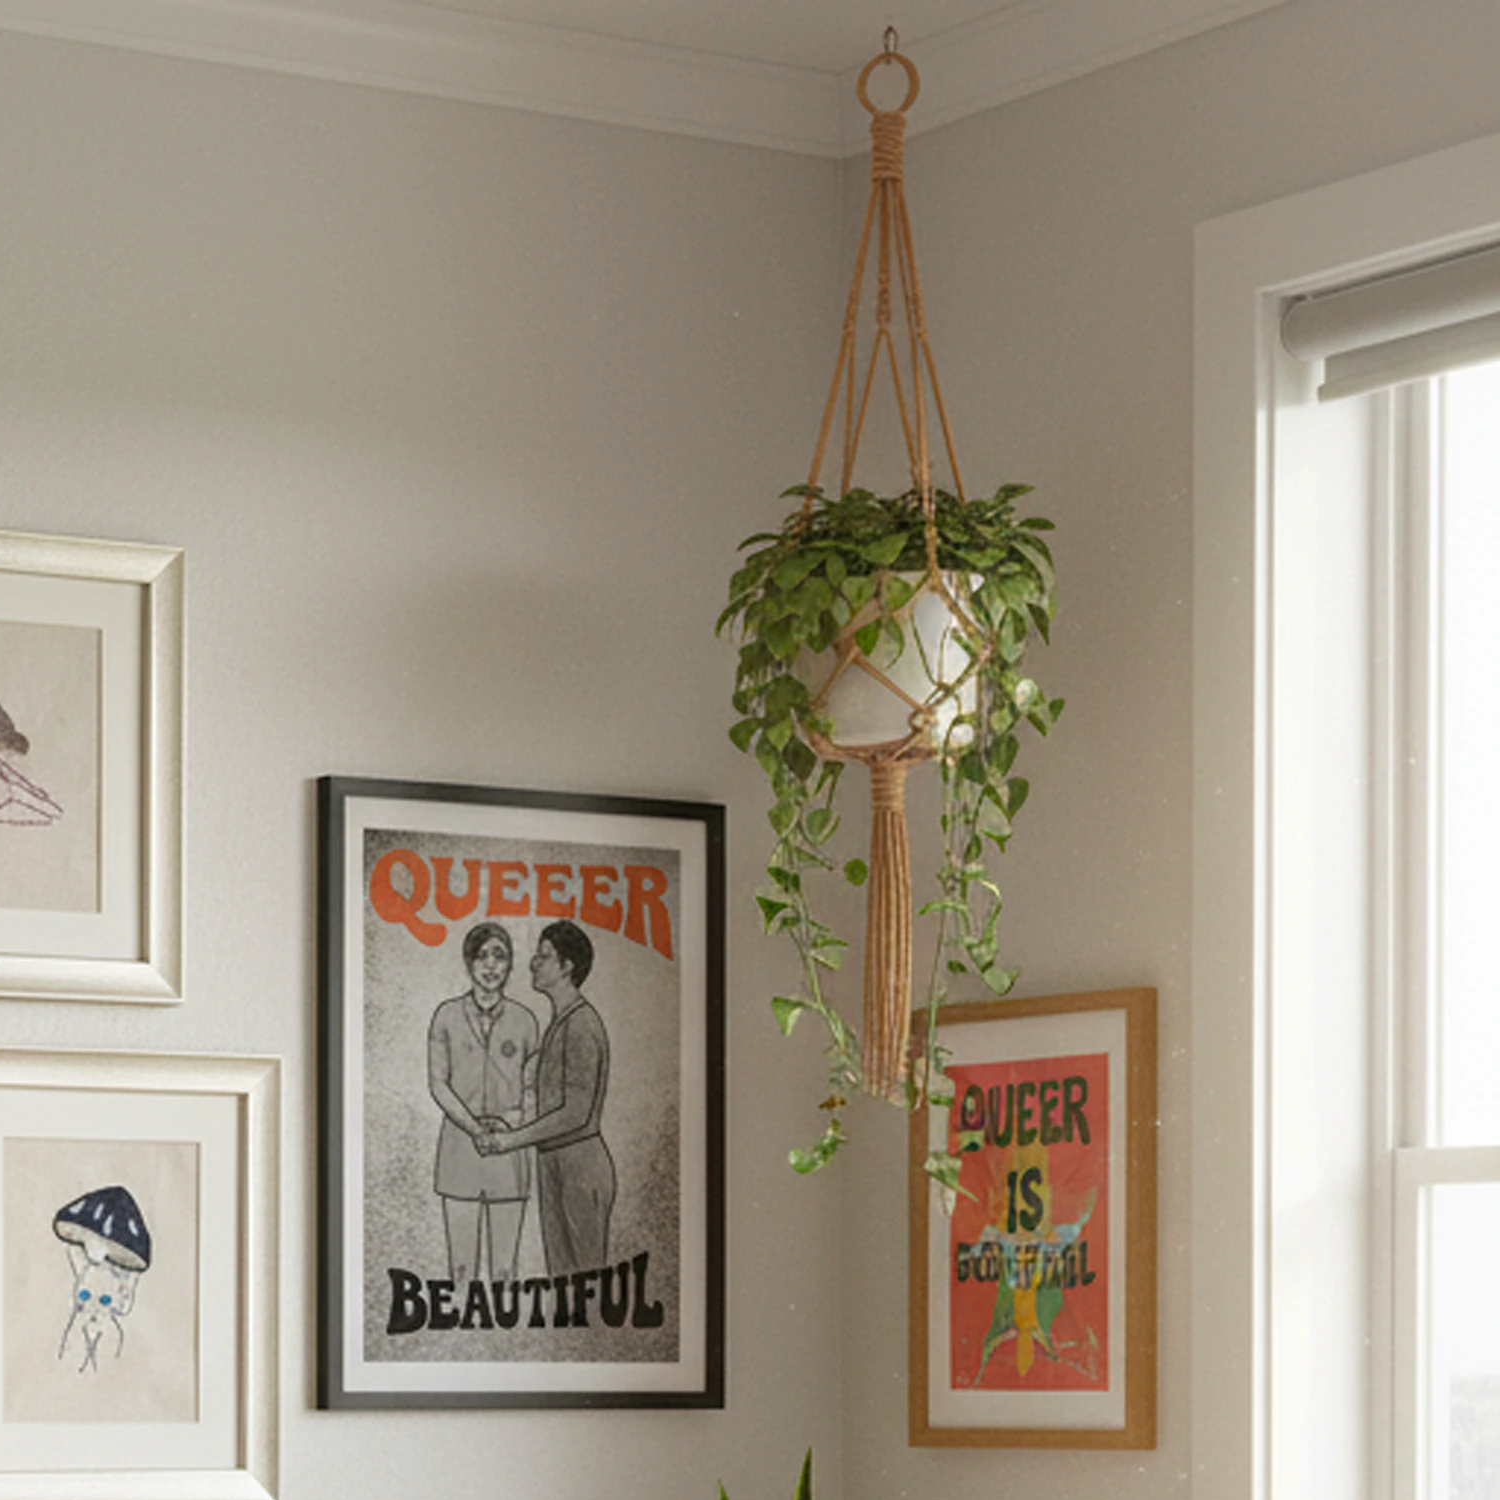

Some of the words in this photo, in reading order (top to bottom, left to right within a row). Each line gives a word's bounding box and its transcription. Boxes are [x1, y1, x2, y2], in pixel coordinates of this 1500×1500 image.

[370, 849, 673, 962] QUEEER
[961, 1075, 1091, 1151] QUEER
[1007, 1167, 1044, 1234] IS
[386, 1251, 665, 1335] BEAUTIFUL
